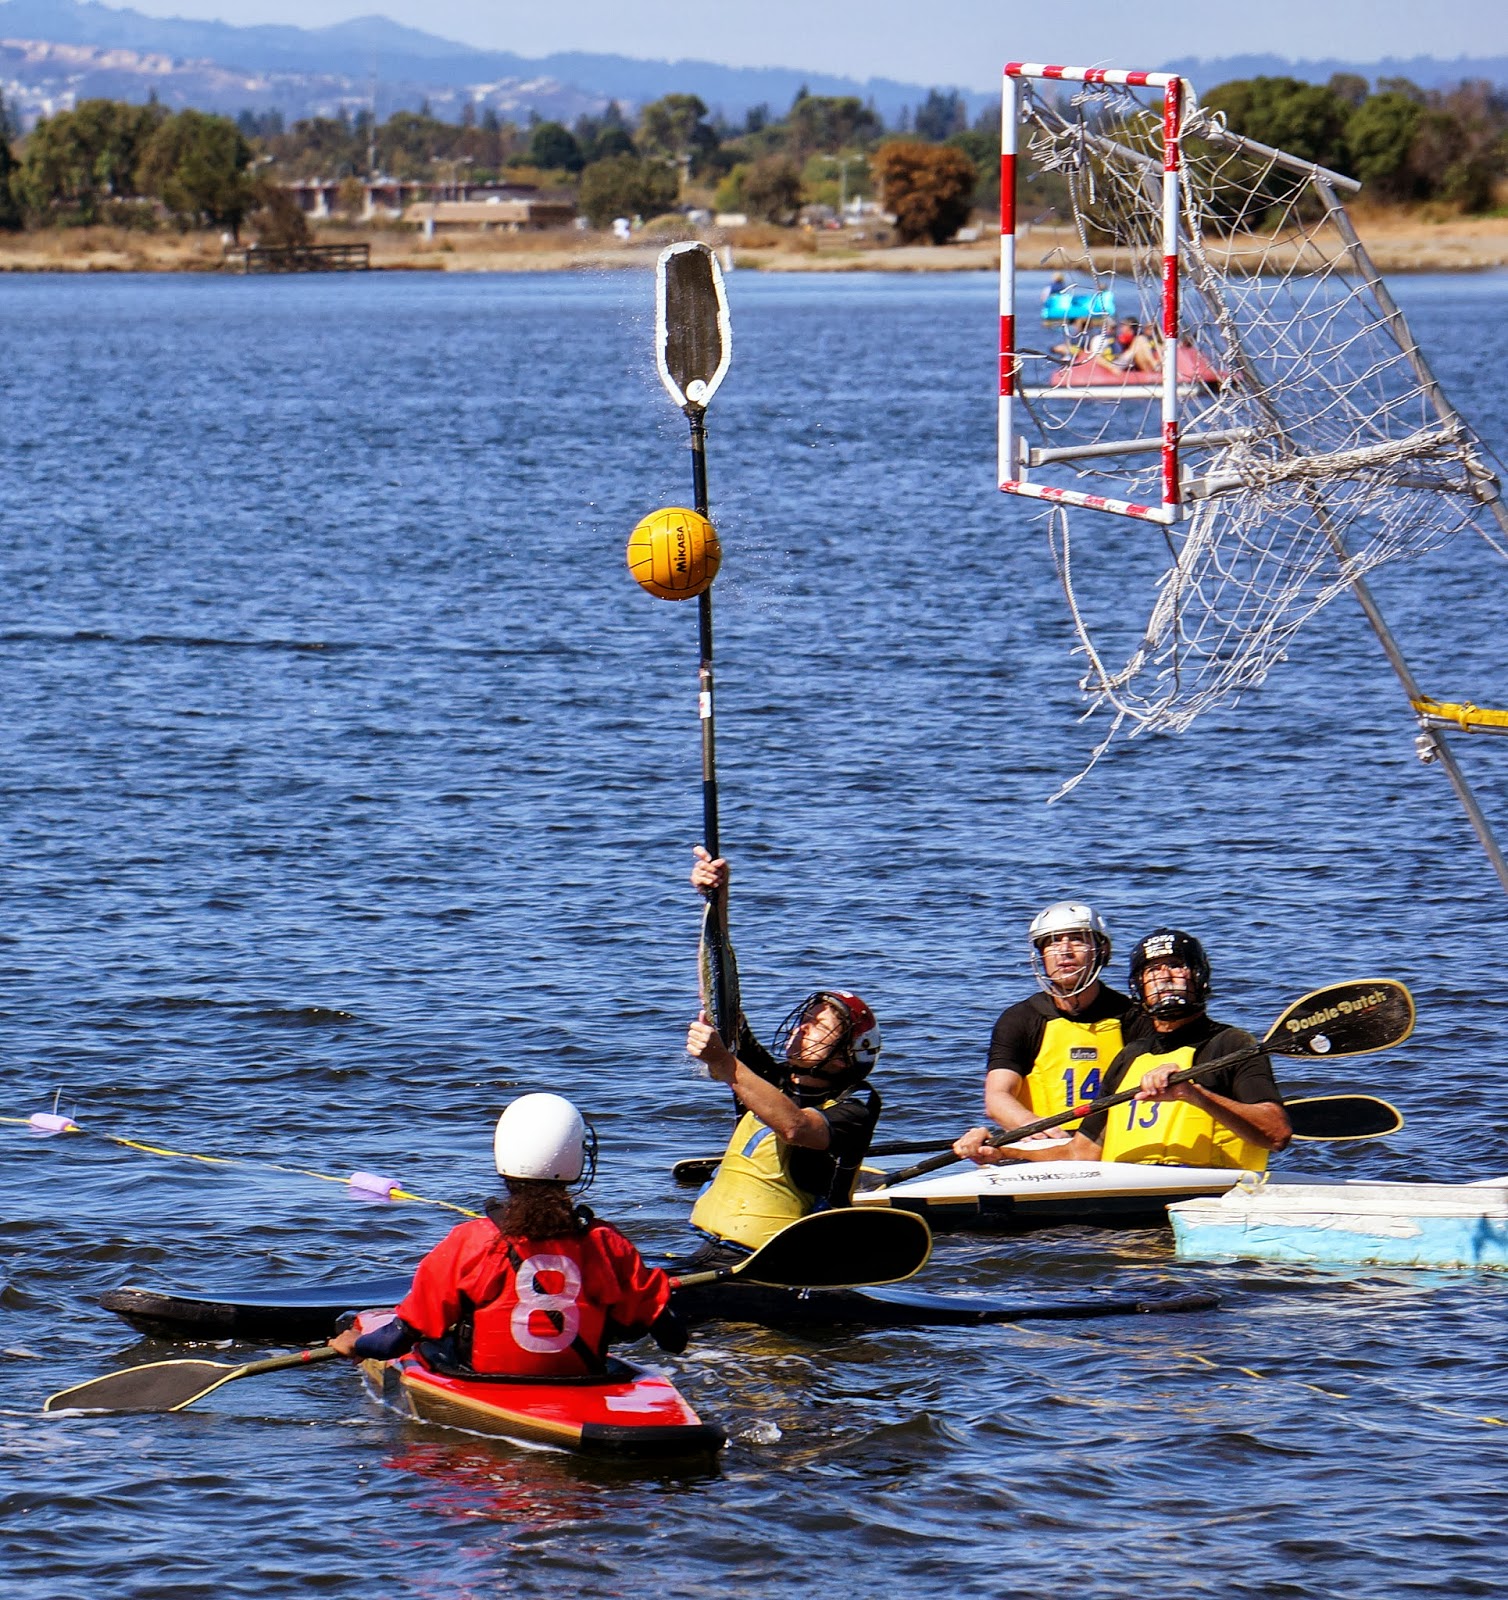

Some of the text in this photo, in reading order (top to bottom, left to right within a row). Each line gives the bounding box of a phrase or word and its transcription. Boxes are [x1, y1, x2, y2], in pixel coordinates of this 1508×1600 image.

[1286, 990, 1387, 1033] Double Dutch
[1061, 1067, 1101, 1107] 14
[1127, 1098, 1161, 1131] 13
[510, 1253, 581, 1354] 8
